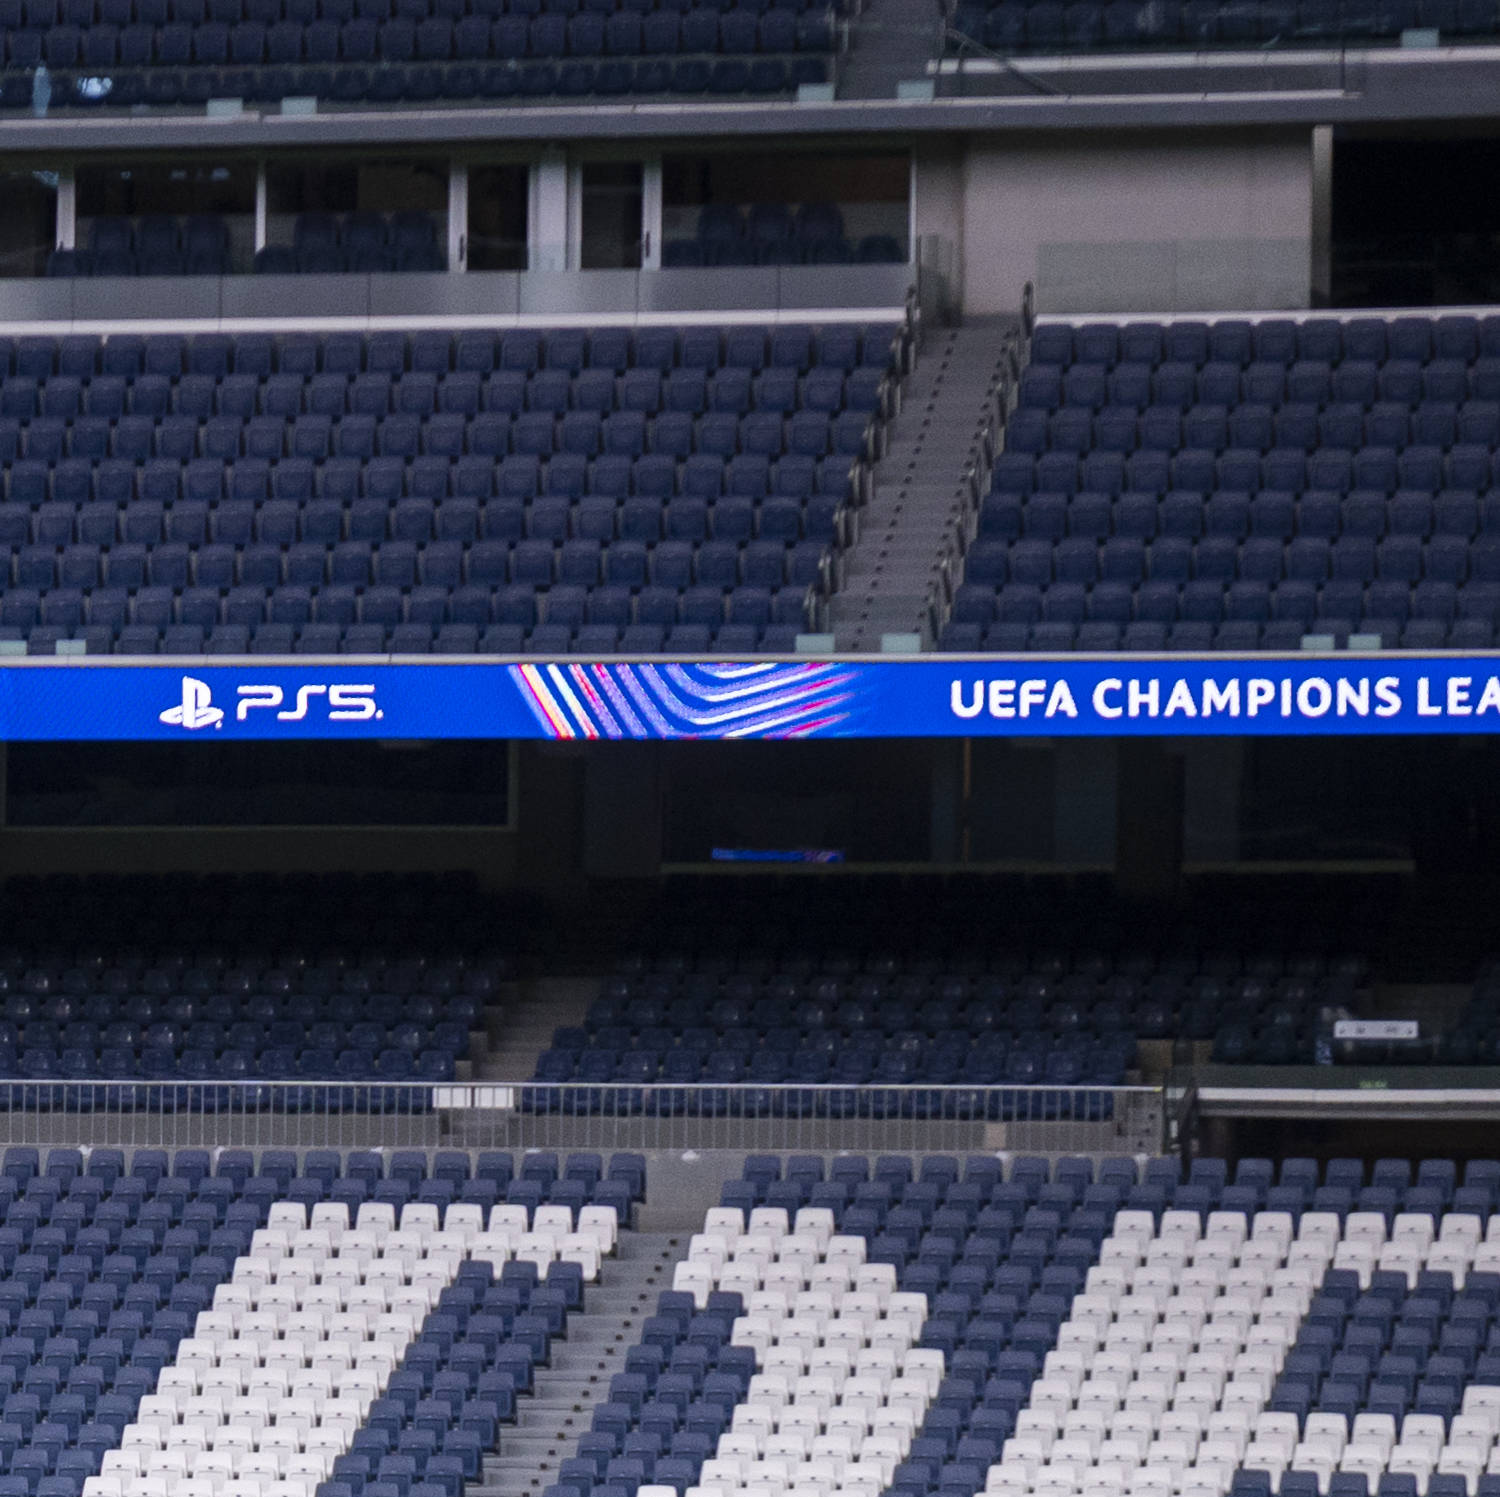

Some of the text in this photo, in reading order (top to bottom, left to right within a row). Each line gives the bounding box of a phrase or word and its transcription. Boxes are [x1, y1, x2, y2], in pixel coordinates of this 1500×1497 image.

[236, 684, 377, 720] PS5
[950, 675, 1500, 718] UEFA CHAMPIONS LEA
